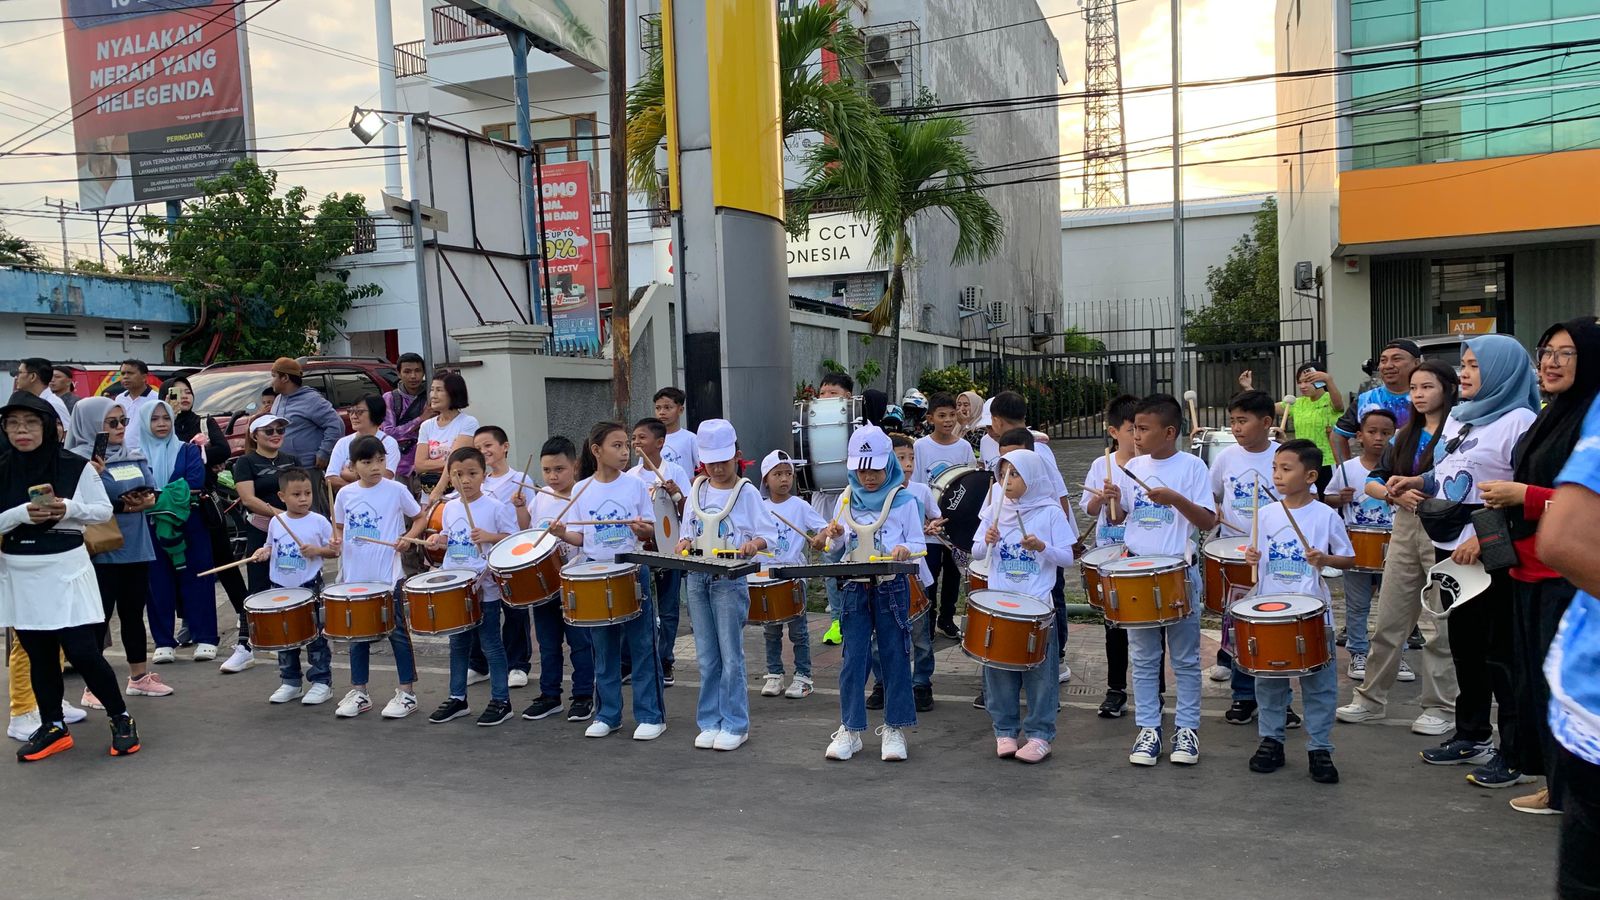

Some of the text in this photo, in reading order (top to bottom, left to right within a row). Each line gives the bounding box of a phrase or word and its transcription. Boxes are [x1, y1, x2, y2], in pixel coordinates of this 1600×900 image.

[96, 23, 202, 61] NYALAKAN
[90, 48, 217, 90] MERAH YANG
[96, 78, 215, 115] MELEGENDA
[139, 160, 153, 168] SAYA
[152, 157, 176, 165] TERKENA
[175, 153, 198, 162] KANKER
[551, 231, 562, 239] UP
[563, 229, 574, 237] TO
[819, 223, 872, 241] CCTV
[556, 263, 579, 273] CCTV
[1453, 321, 1476, 332] ATM
